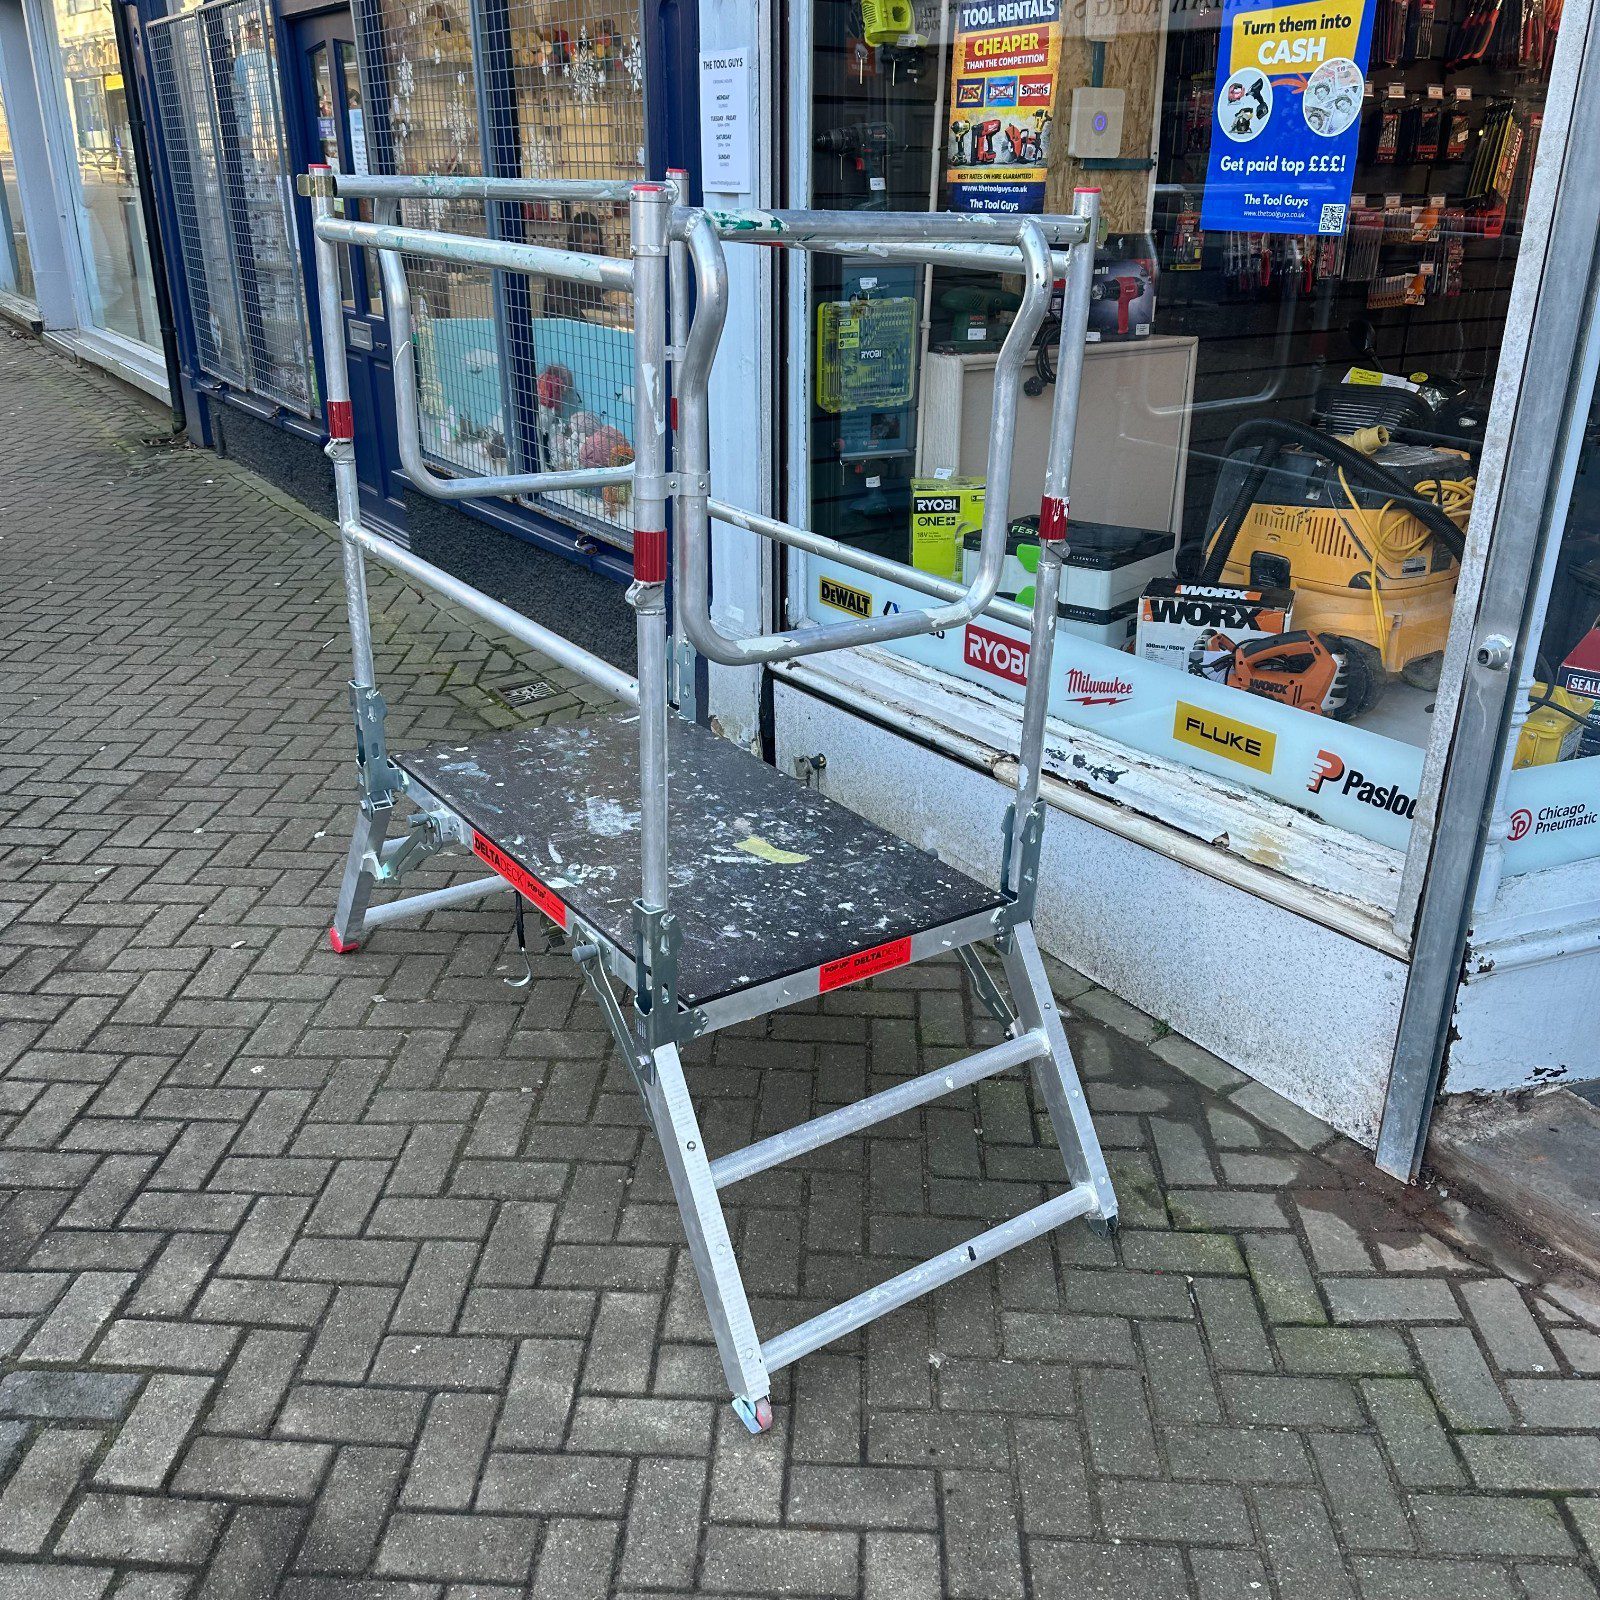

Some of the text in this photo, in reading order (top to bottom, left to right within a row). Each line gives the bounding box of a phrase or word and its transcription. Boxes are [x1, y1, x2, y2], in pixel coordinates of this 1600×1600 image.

[963, 7, 996, 27] TOOL
[998, 0, 1056, 22] RENTALS
[1243, 13, 1352, 36] Turn them into
[973, 32, 1040, 57] CHEAPER
[1257, 36, 1327, 66] CASH
[703, 57, 743, 71] THE TOOL GUYS
[966, 53, 1045, 70] THAN THE COMPETITION
[1220, 154, 1347, 177] Get paid top £££!
[961, 184, 1028, 194] www.thetoolguys.co.uk
[969, 198, 1019, 213] The Tool Guys
[1244, 193, 1309, 209] The Tool Guys
[1243, 210, 1306, 218] www.thetoolguys.co.uk
[860, 349, 882, 359] RYOBI
[916, 498, 957, 512] RYOBI
[1179, 584, 1248, 600] WORX
[1150, 599, 1263, 632] WORX
[968, 632, 1030, 678] RYOBI
[1065, 667, 1134, 695] Milwaukee
[1249, 677, 1289, 695] WORX
[1185, 716, 1262, 758] FLUKE
[1538, 803, 1586, 822] Chicago
[1535, 812, 1598, 835] Pneumatic
